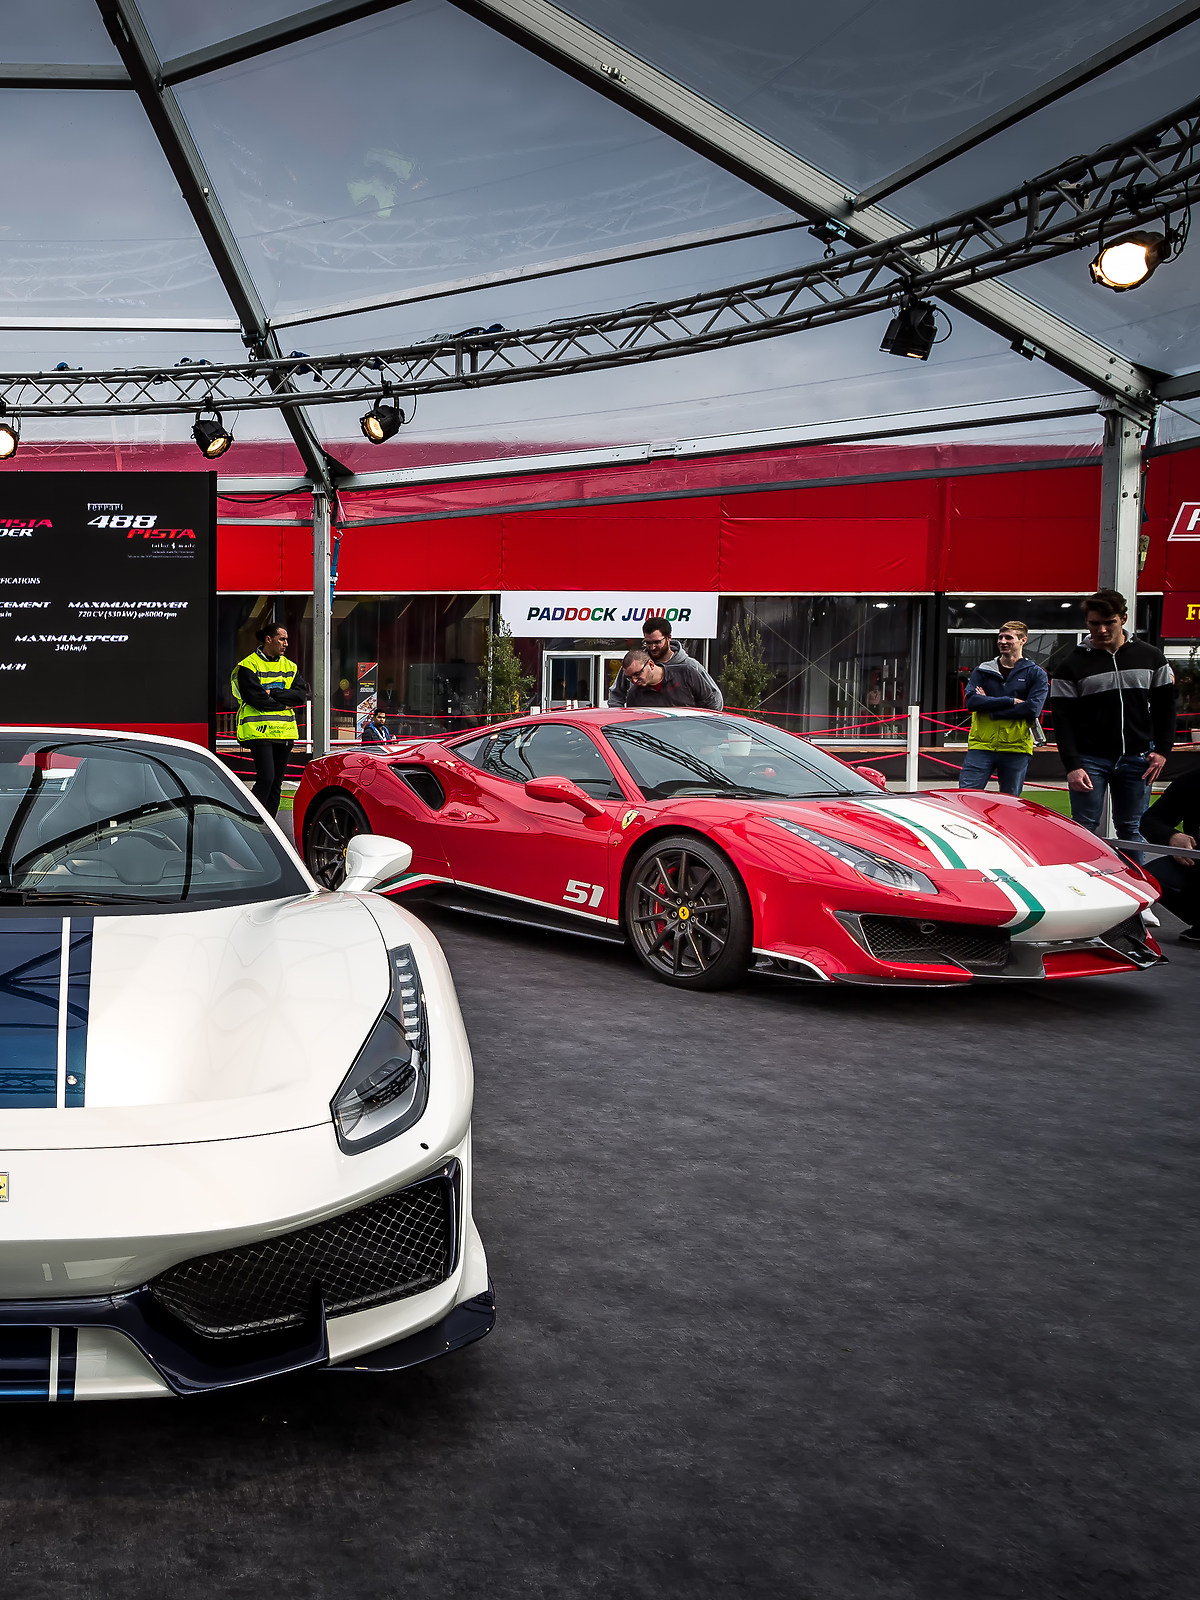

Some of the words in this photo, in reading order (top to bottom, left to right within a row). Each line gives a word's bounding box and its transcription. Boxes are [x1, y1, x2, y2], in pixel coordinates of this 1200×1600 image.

[87, 514, 158, 528] 488
[126, 528, 197, 539] PISTA
[68, 601, 136, 609] MAXIMUM
[136, 601, 189, 609] POWER
[526, 606, 617, 622] PADDOCK
[621, 606, 692, 622] JUNIOR
[14, 634, 84, 642] MAXIMUM
[83, 634, 129, 642] SPEED
[55, 644, 69, 652] 340
[69, 644, 88, 652] km/h
[562, 879, 605, 908] 51
